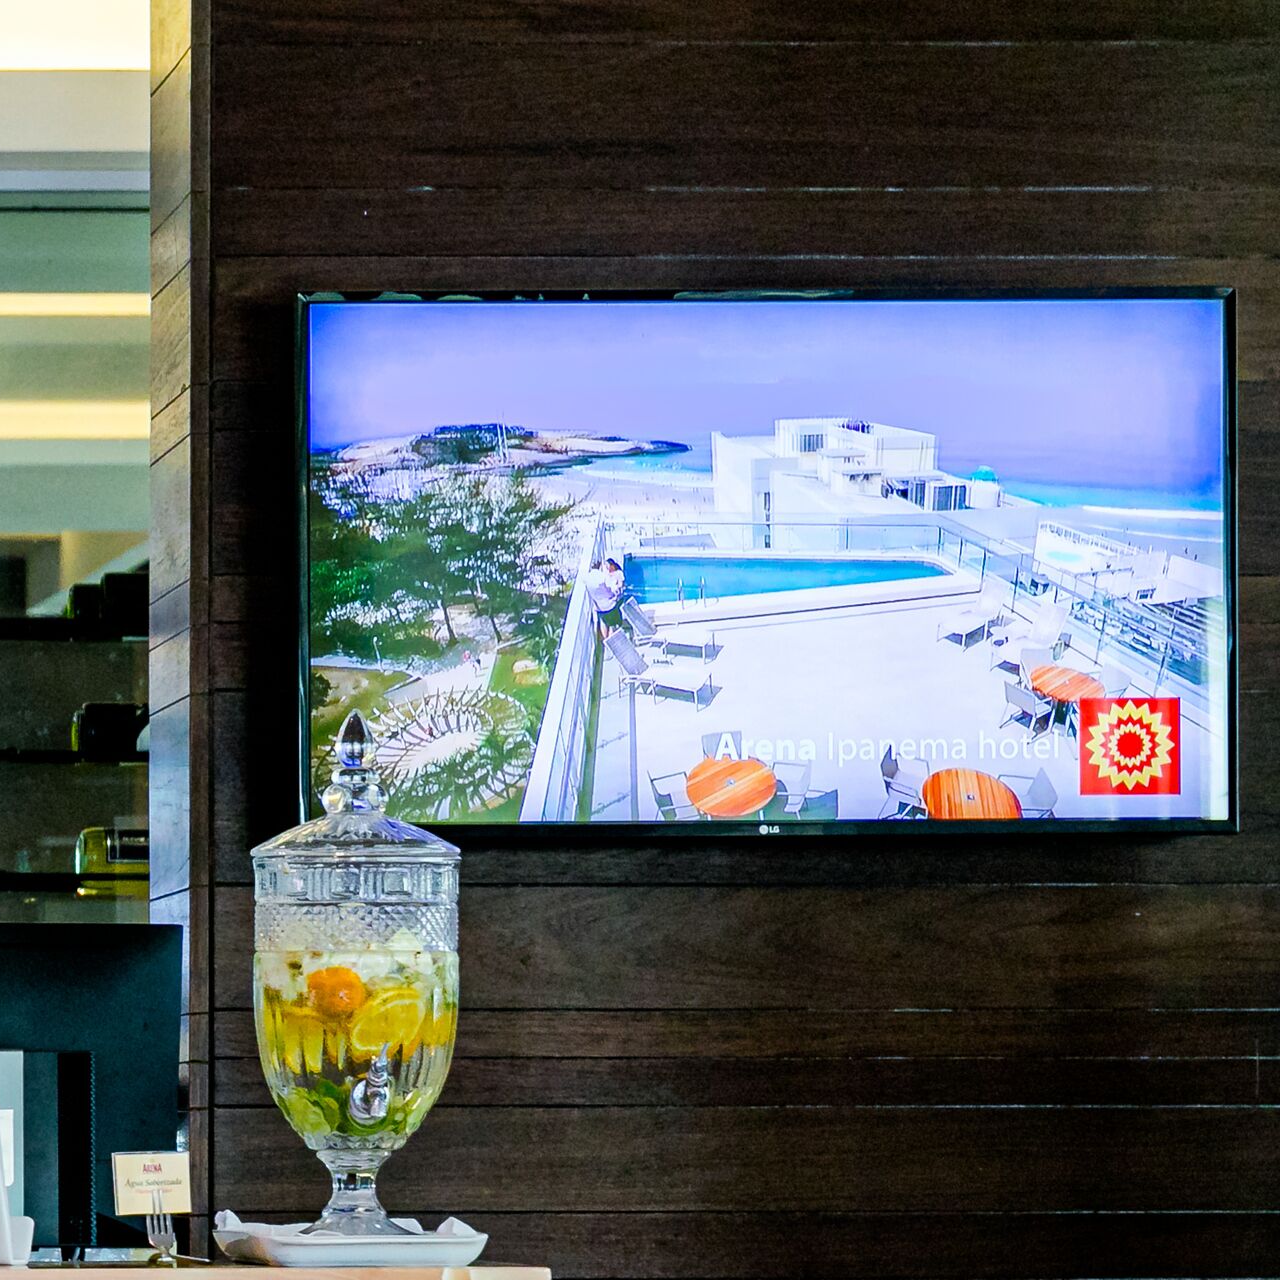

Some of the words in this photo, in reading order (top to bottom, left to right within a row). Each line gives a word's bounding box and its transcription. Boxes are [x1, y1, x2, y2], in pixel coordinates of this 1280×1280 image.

[715, 731, 816, 762] Arena
[827, 732, 967, 767] Ipanema
[979, 730, 1061, 761] hotel
